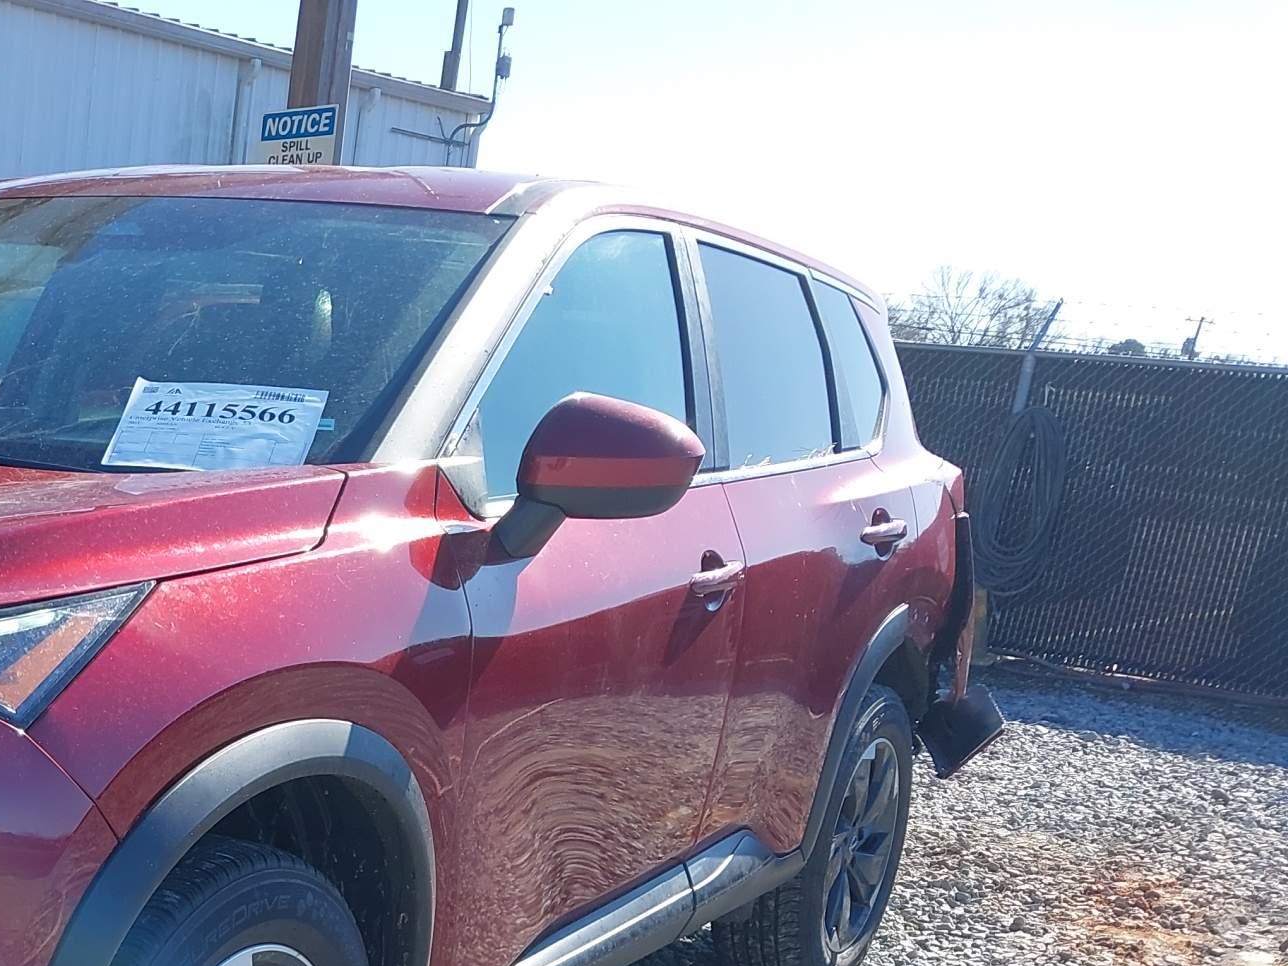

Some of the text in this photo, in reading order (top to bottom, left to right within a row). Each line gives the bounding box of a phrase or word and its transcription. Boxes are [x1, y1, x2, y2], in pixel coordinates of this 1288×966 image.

[264, 112, 332, 136] NOTICE
[281, 139, 311, 153] SPILL
[307, 151, 322, 163] UP
[145, 400, 297, 425] 44115566
